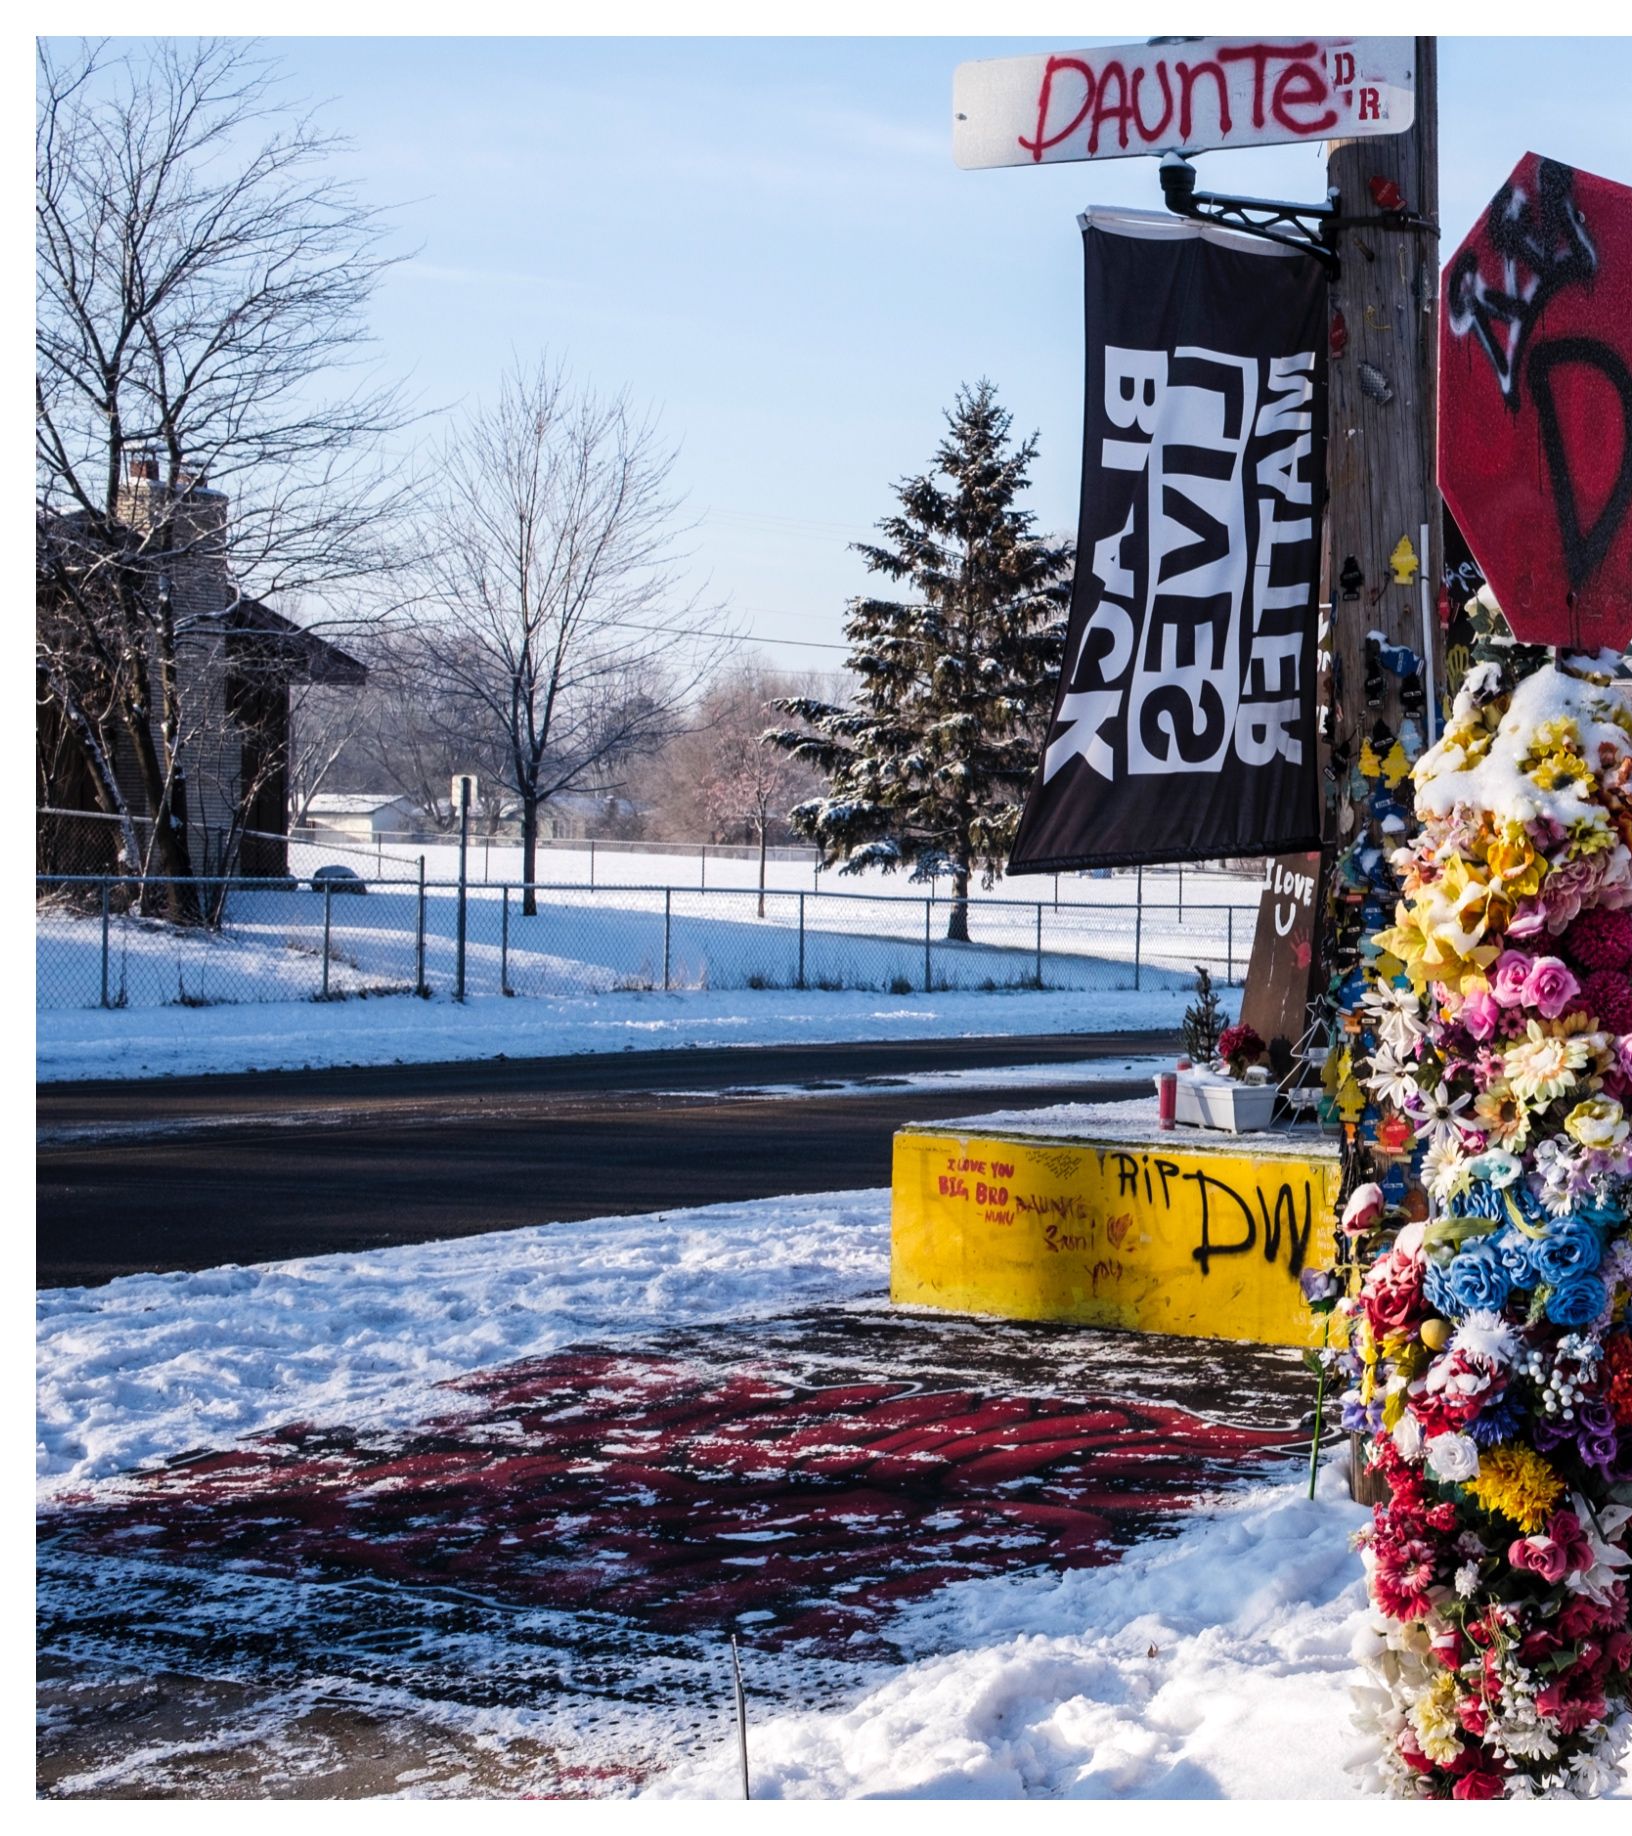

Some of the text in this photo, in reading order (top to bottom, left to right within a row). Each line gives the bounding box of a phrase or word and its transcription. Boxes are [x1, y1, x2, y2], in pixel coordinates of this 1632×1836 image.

[1263, 858, 1315, 906] I LOVE
[1274, 902, 1296, 936] U
[957, 1159, 987, 1175] LOVE
[990, 1161, 1015, 1179] YOU
[938, 1175, 1009, 1206] BIG BRO
